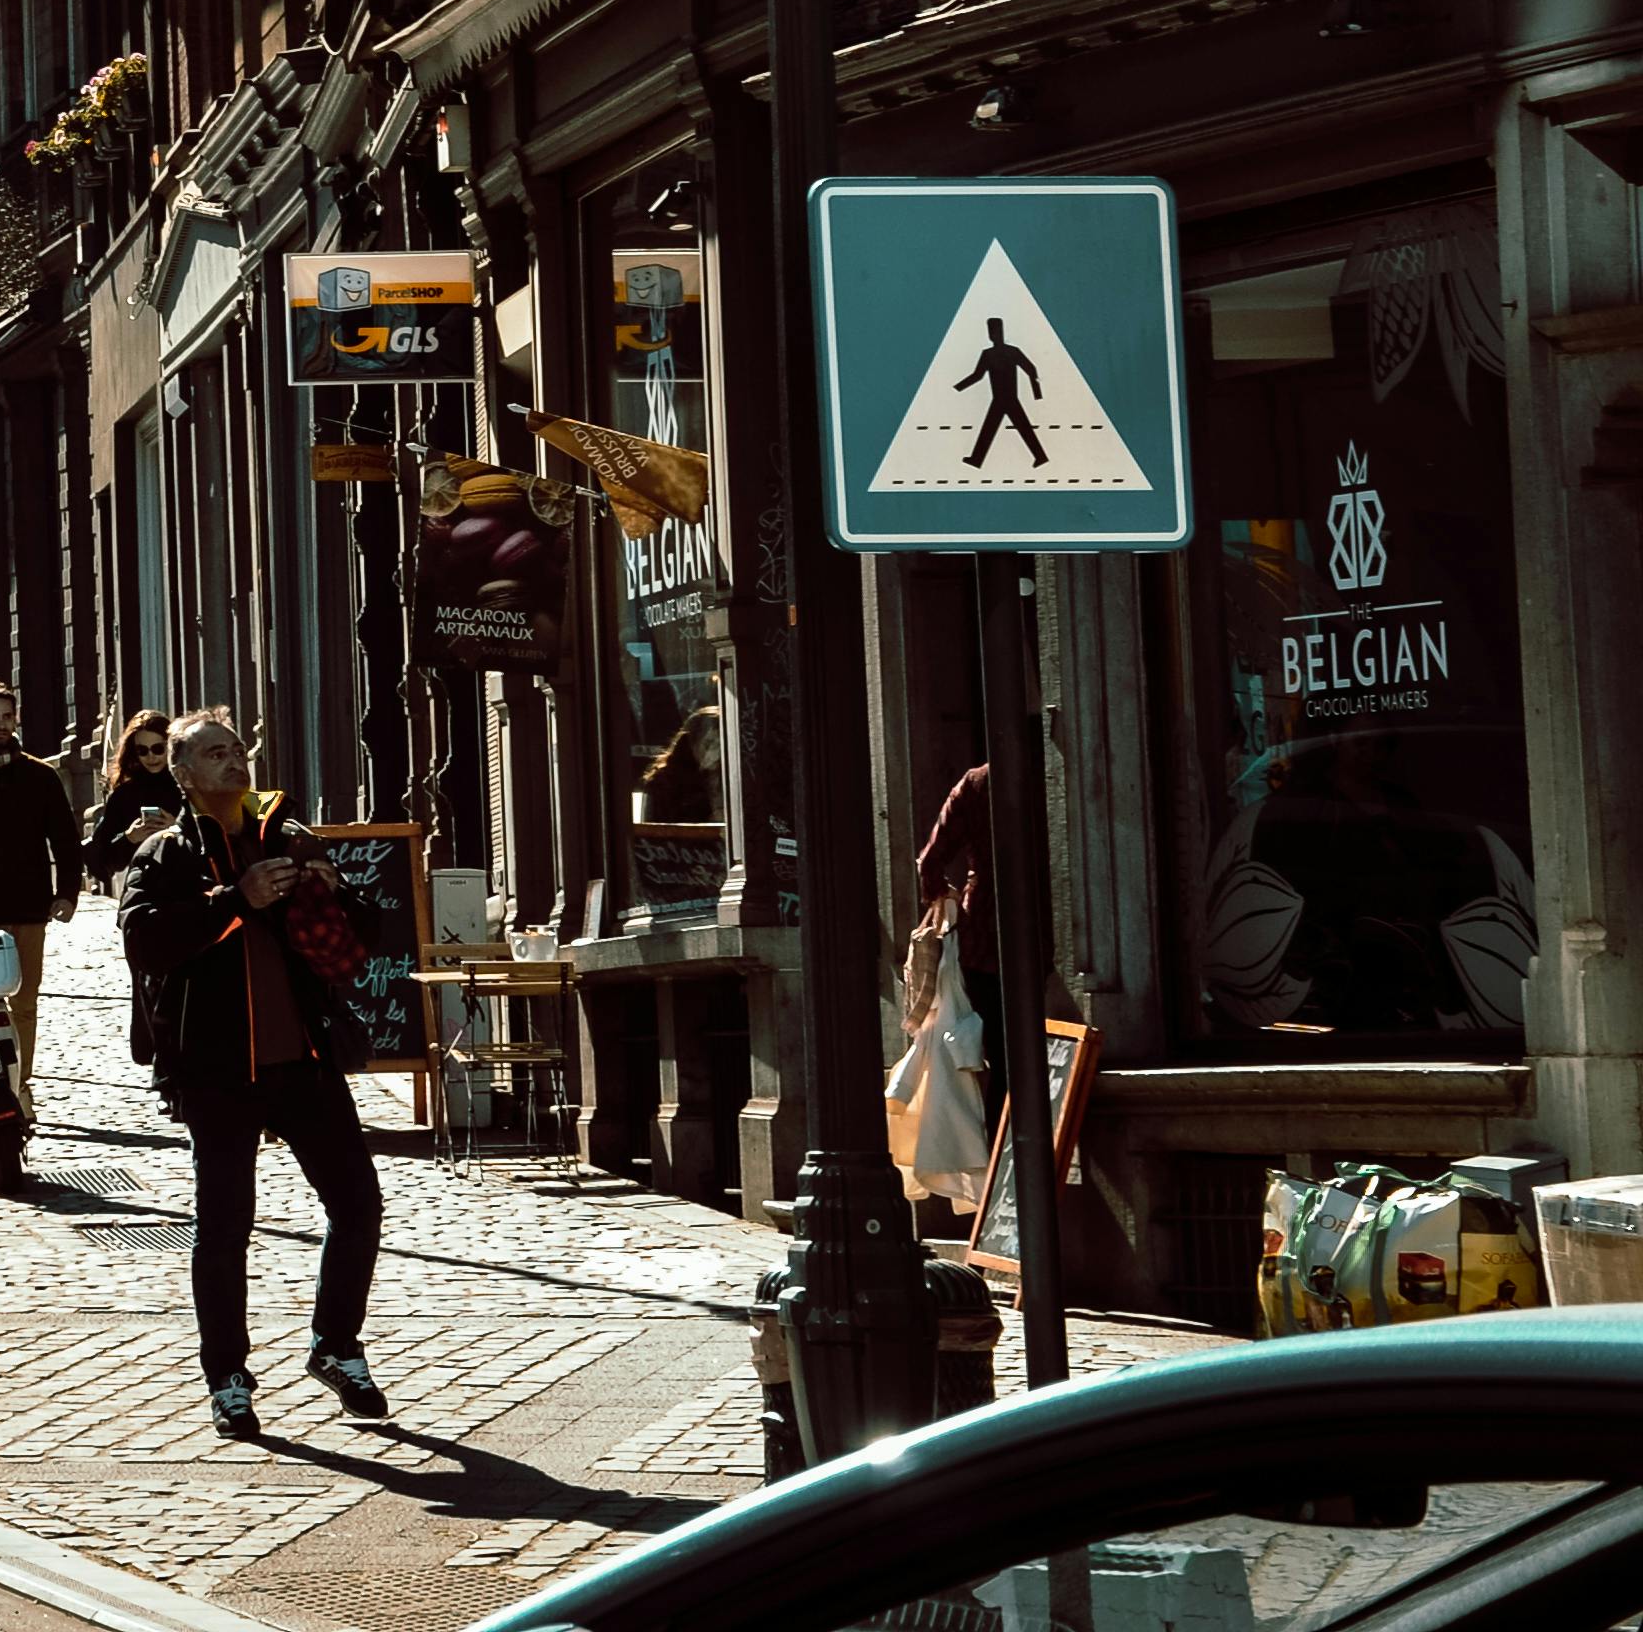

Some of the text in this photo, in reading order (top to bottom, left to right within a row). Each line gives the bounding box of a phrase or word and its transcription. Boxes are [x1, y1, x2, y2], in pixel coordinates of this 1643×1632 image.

[379, 287, 444, 299] ParcelSHOP
[390, 327, 440, 353] GLS
[436, 606, 526, 625] MACARONS
[1348, 602, 1374, 622] THE
[435, 621, 535, 641] ARTISANAUX
[1282, 621, 1449, 695] BELGIAN
[1306, 689, 1430, 718] CHOCOLATE MAKERS
